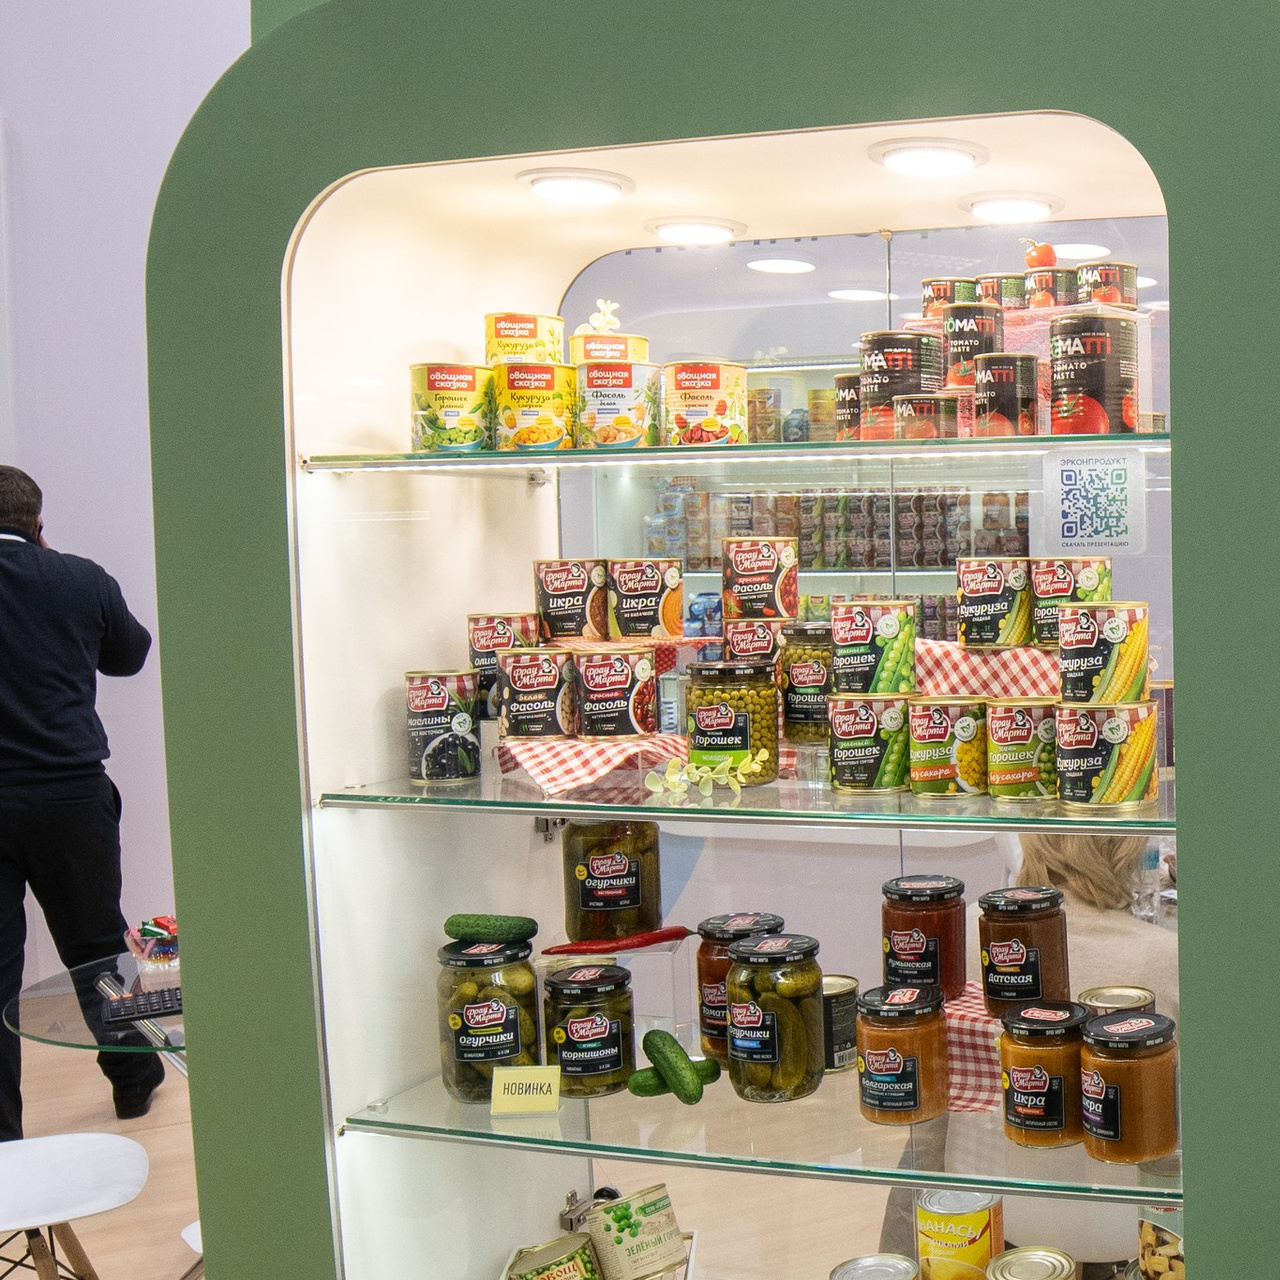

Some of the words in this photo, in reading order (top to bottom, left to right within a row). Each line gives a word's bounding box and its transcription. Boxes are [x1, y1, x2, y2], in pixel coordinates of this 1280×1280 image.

[430, 372, 472, 381] овощная
[510, 372, 551, 381] овощная
[589, 370, 628, 380] овощная
[677, 372, 716, 381] овощная
[976, 369, 1014, 383] MATTI
[1054, 372, 1075, 380] PASTE
[435, 380, 467, 389] сказка
[514, 380, 546, 388] сказка
[593, 378, 623, 386] сказка
[681, 380, 711, 388] сказка
[511, 393, 550, 403] Кукуруза
[592, 391, 626, 399] Фасоль
[1061, 458, 1126, 466] ЭРКОНПРОДУКТ
[736, 551, 757, 564] Фрау
[739, 560, 772, 570] Марта
[546, 572, 567, 585] Фрау
[620, 572, 641, 585] Фрау
[964, 574, 983, 587] Фрау
[1036, 575, 1053, 588] Фрау
[549, 580, 582, 590] Марта
[622, 580, 656, 591] Марта
[733, 583, 773, 593] Фасоль
[965, 581, 998, 592] Марта
[1037, 583, 1068, 593] Марта
[834, 620, 851, 631] Фрау
[474, 629, 493, 640] Фрау
[732, 633, 753, 645] Фрау
[836, 629, 866, 641] Марта
[478, 637, 508, 648] Марта
[735, 641, 768, 651] Марта
[834, 654, 875, 666] Горошек
[513, 667, 538, 681] Фрау
[586, 666, 610, 680] Фрау
[792, 667, 809, 679] Фрау
[795, 674, 822, 683] Марта
[518, 676, 553, 687] Марта
[590, 675, 625, 687] Марта
[411, 697, 442, 708] Марта
[510, 700, 554, 712] Фасоль
[584, 700, 627, 711] Фасоль
[699, 710, 717, 721] Фрау
[835, 714, 855, 727] Фрау
[701, 717, 729, 727] Марта
[912, 717, 929, 729] Фрау
[991, 719, 1011, 731] Фрау
[838, 722, 871, 734] Марта
[914, 728, 944, 738] Марта
[993, 729, 1027, 741] Марта
[696, 736, 742, 746] Горошек
[834, 746, 880, 760] Горошек
[990, 750, 1034, 763] Горошек
[592, 859, 612, 870] Фрау
[595, 865, 624, 874] Марта
[585, 877, 636, 889] Огурчики
[893, 935, 910, 944] Фрау
[896, 942, 921, 950] Марта
[992, 946, 1009, 956] Фрау
[995, 954, 1021, 962] Марта
[988, 973, 1032, 983] Датская
[467, 1006, 488, 1018] Фрау
[471, 1012, 502, 1024] Марта
[571, 1022, 592, 1033] Фрау
[575, 1027, 605, 1038] Марта
[460, 1031, 514, 1047] Огурчики
[562, 1046, 618, 1060] Корнишоны
[868, 1055, 886, 1065] Фрау
[871, 1062, 898, 1072] Марта
[1012, 1071, 1031, 1083] Фрау
[503, 1082, 552, 1095] НОВИНКА
[862, 1077, 912, 1091] Болгарская
[1015, 1080, 1045, 1090] Марта
[918, 1221, 981, 1239] НАНАСЫ
